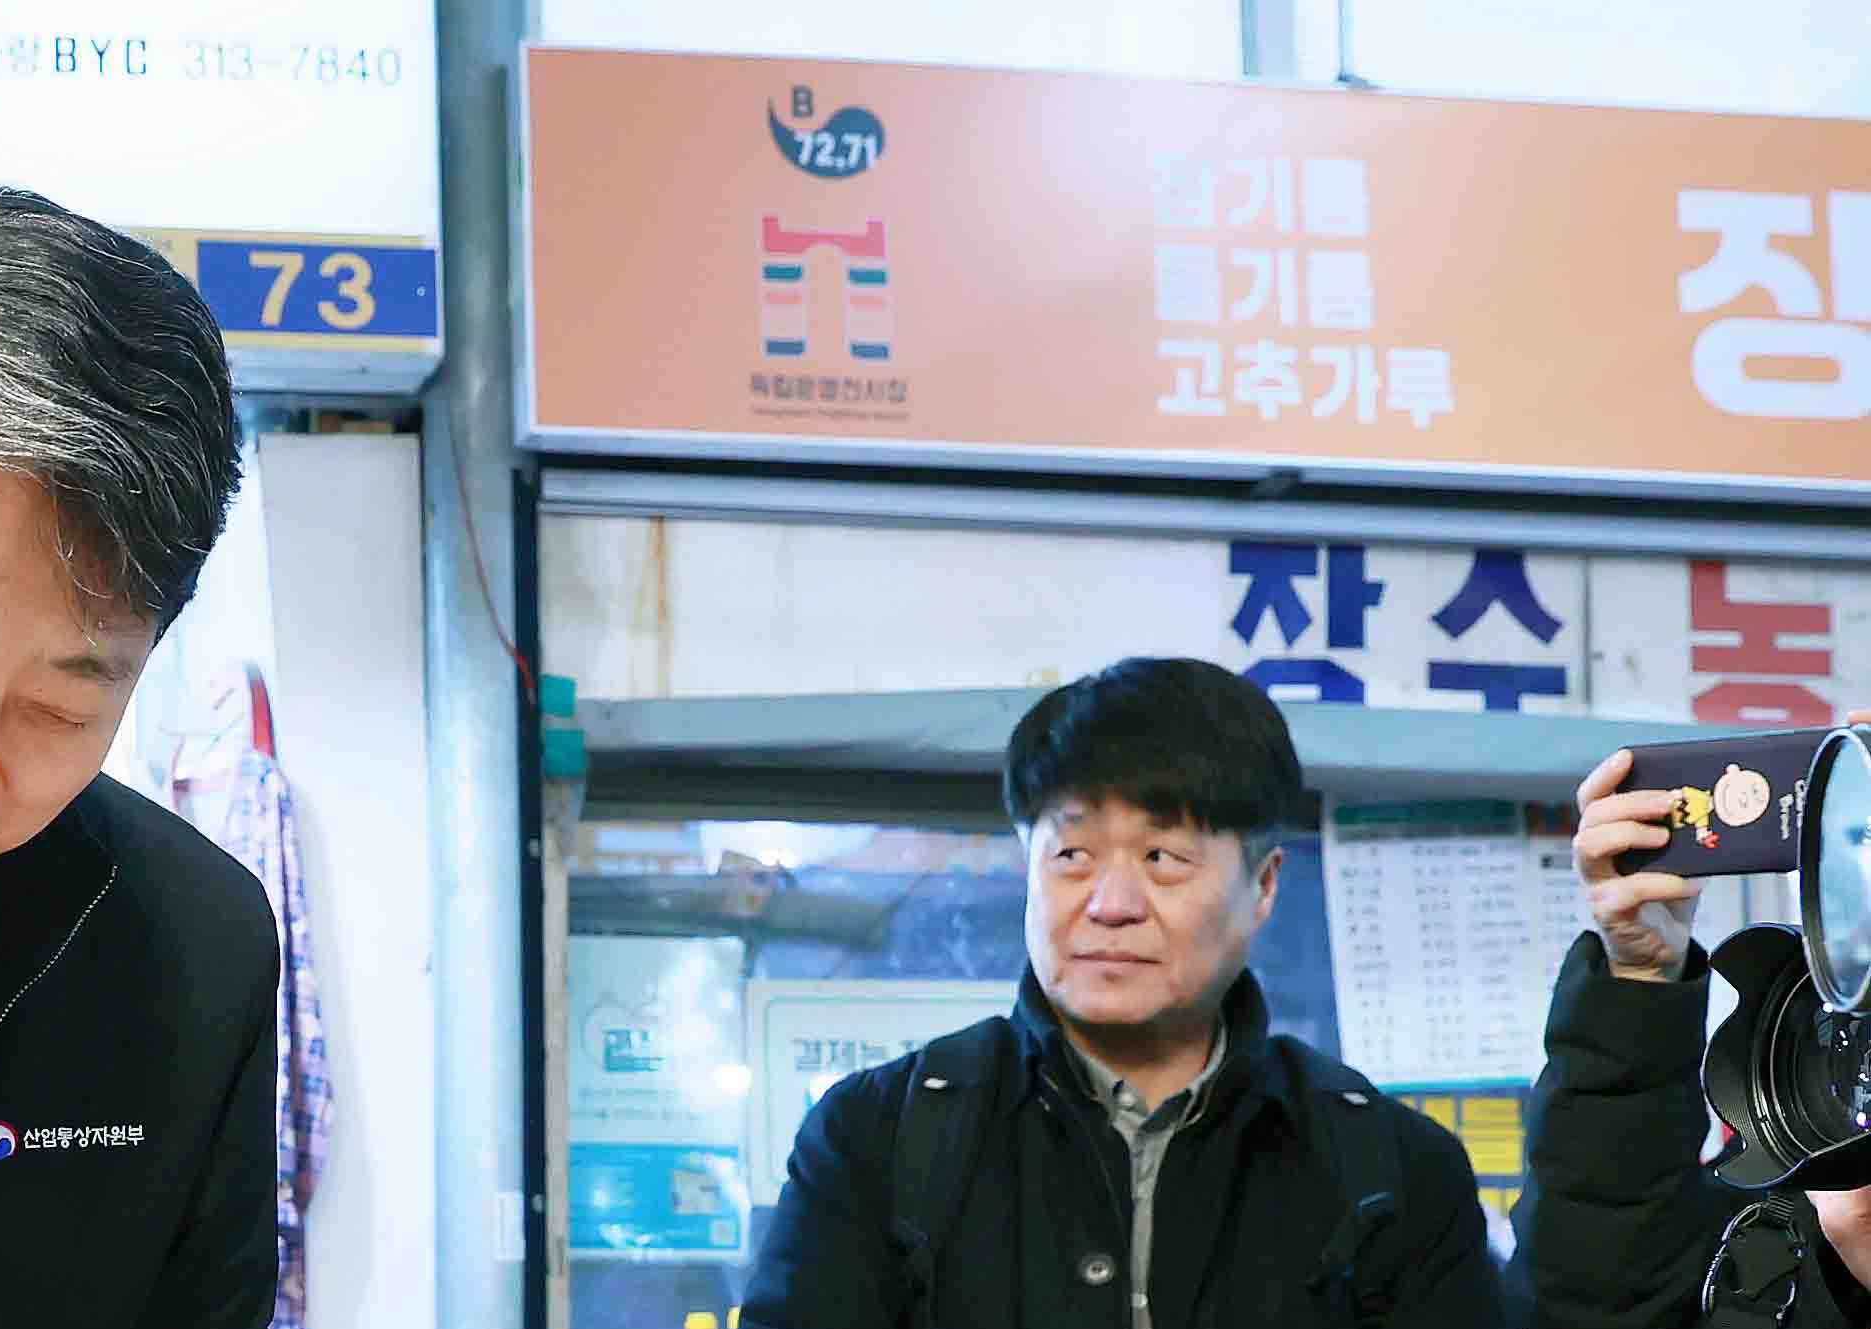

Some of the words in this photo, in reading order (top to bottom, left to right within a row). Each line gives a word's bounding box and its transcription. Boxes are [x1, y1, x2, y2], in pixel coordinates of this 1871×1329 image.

[55, 37, 147, 76] BYC
[791, 85, 814, 118] B
[248, 252, 377, 330] 73
[1154, 337, 1456, 428] 고추가루
[23, 1125, 146, 1149] 산업통상자원부
